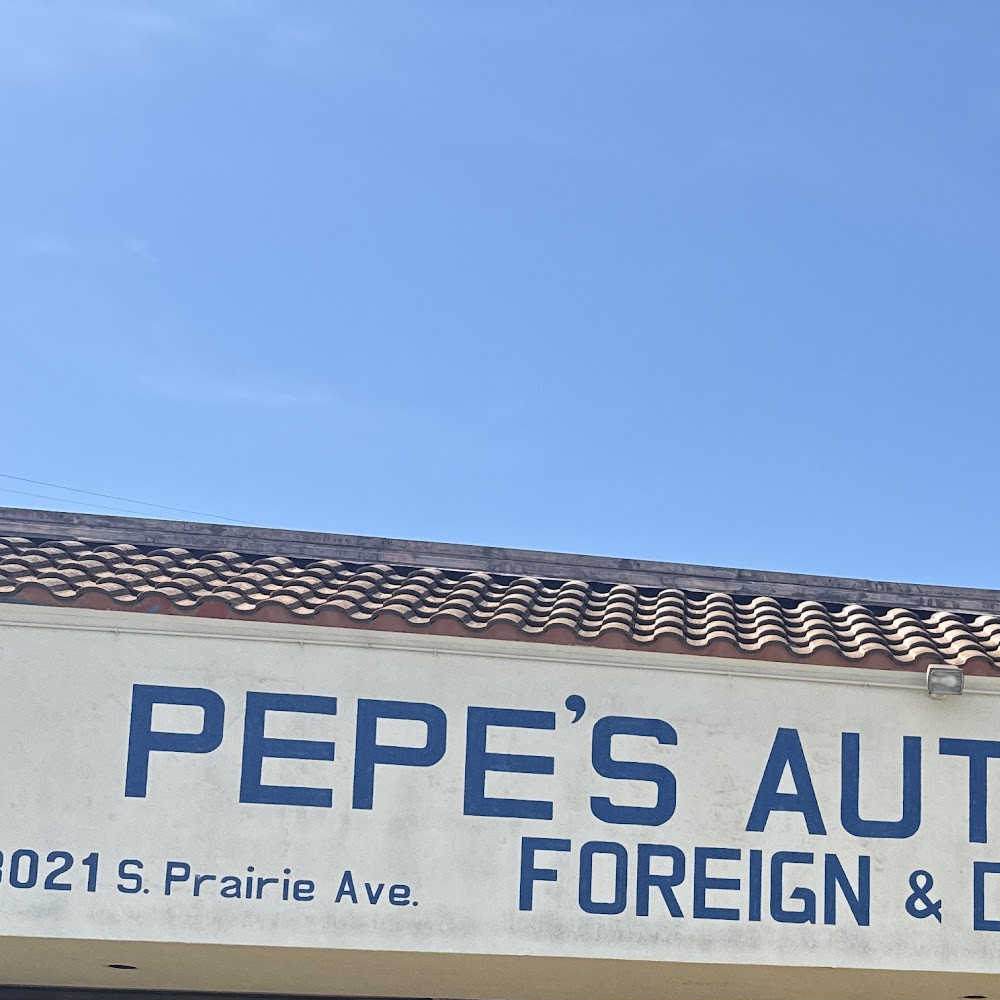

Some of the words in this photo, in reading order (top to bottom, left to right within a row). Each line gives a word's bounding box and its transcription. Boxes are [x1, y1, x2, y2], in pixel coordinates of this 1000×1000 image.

[125, 684, 678, 827] PEPE'S
[0, 849, 98, 892] 021
[117, 859, 149, 894] S.
[165, 862, 315, 901] Prairie
[336, 870, 419, 906] Ave.
[519, 837, 870, 926] FOREIGN
[905, 870, 942, 924] &
